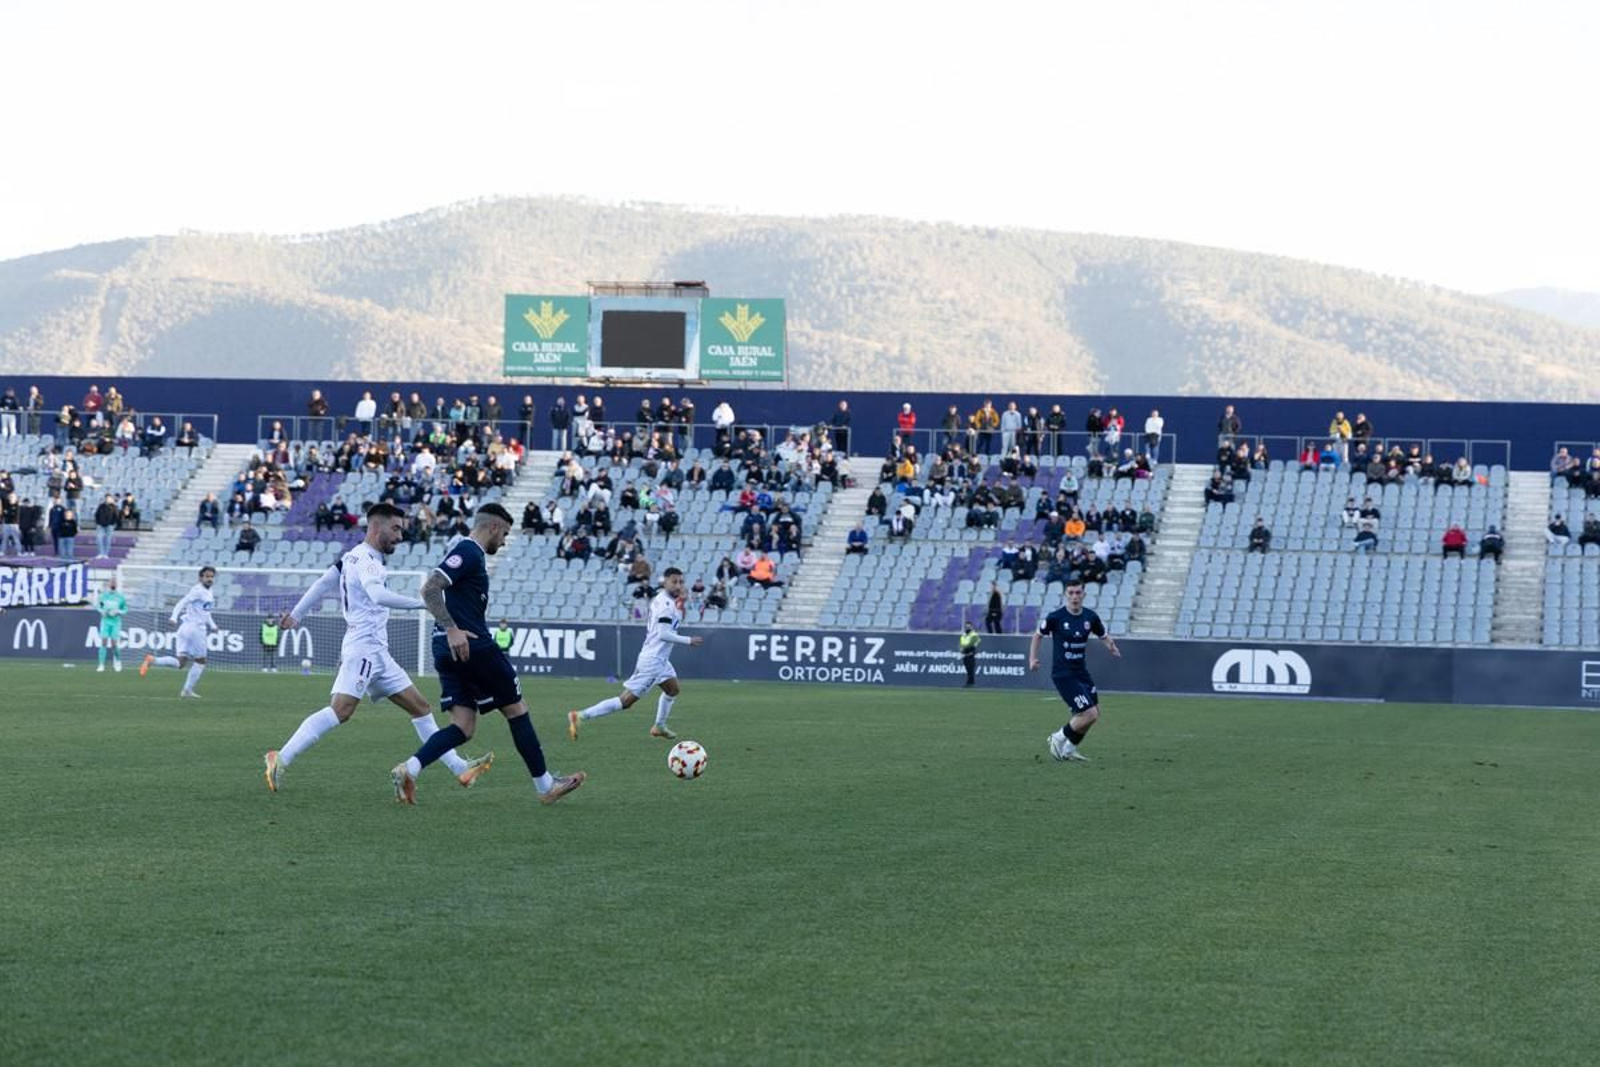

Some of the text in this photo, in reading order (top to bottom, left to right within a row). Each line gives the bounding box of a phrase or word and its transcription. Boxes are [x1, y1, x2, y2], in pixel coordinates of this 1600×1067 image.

[512, 341, 579, 353] CAJA RURAL
[708, 345, 776, 357] CAJA RURAL
[85, 626, 244, 652] McDond's
[360, 658, 372, 678] 11
[779, 665, 885, 683] ORTOPEDIA
[893, 661, 918, 673] JAÉN
[928, 662, 968, 674] ANDÚJA
[983, 665, 1025, 676] LINARES
[1074, 695, 1089, 708] 24
